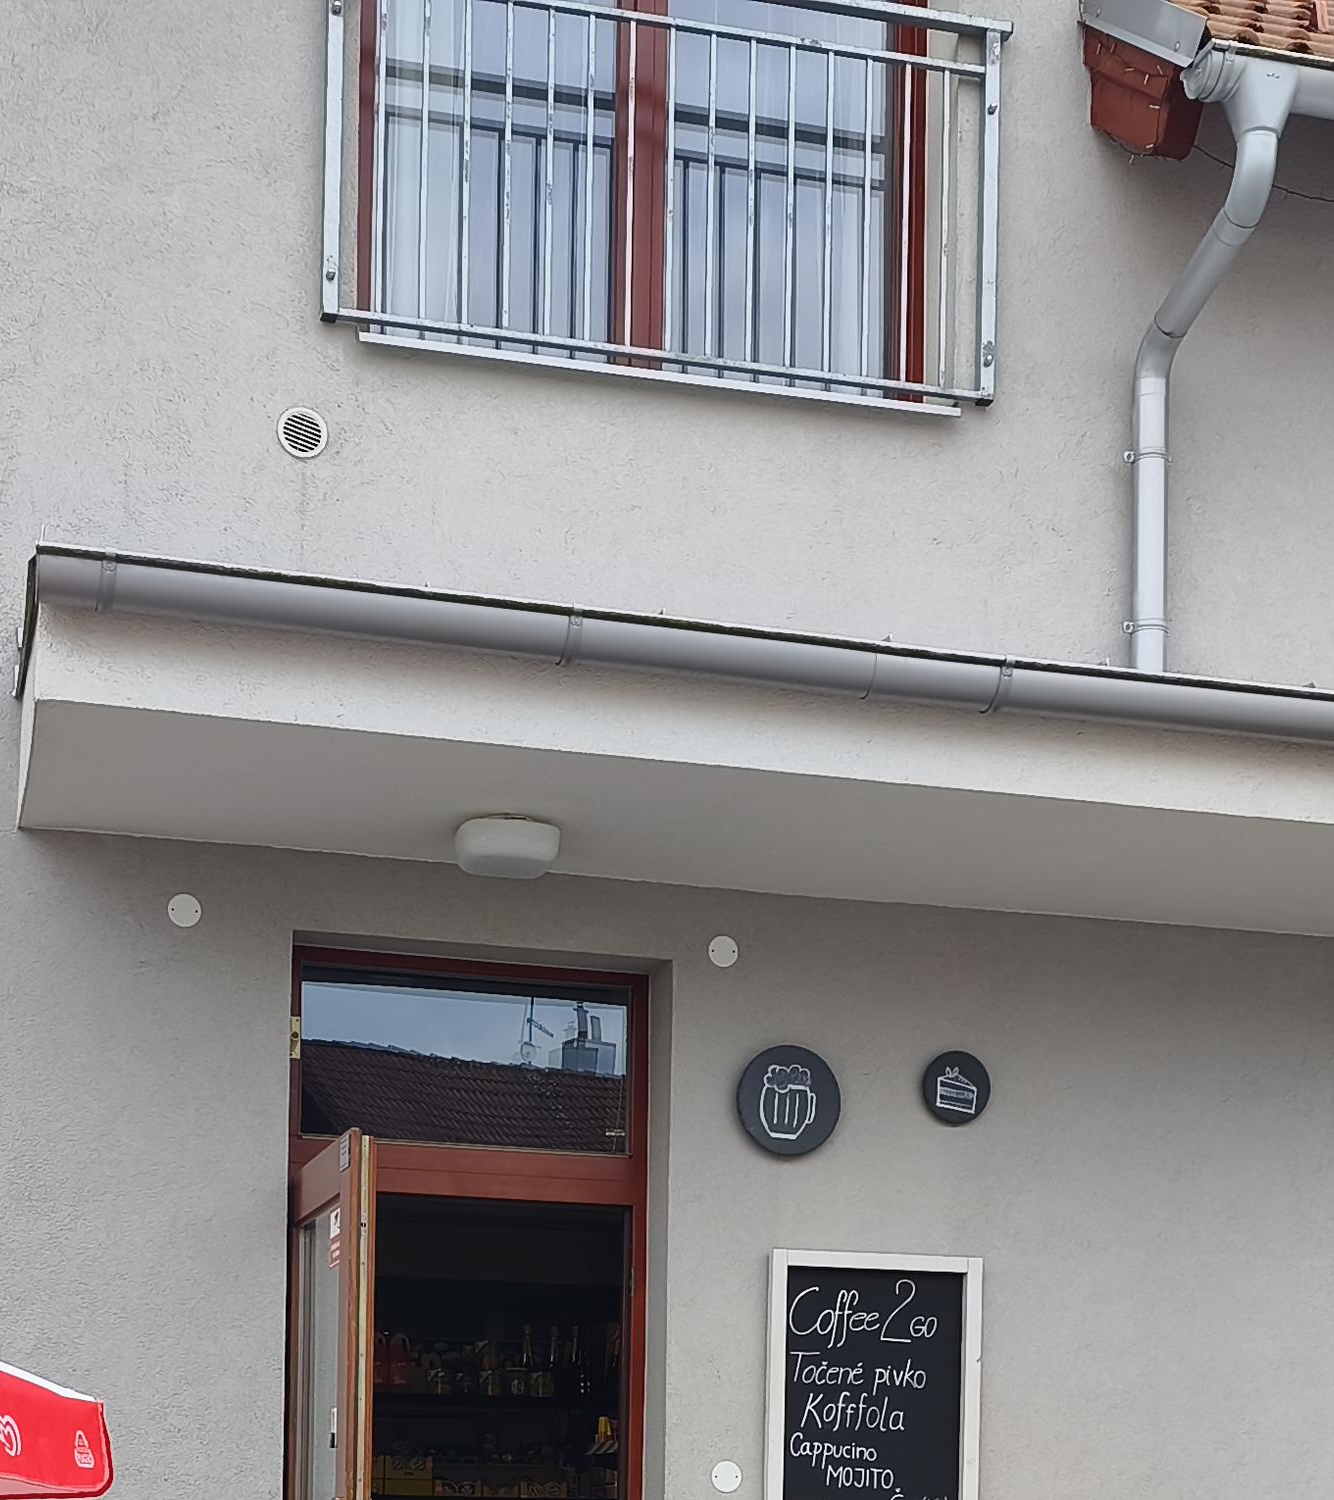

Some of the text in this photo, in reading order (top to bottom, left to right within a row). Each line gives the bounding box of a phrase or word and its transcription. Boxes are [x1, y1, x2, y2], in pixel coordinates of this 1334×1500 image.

[789, 1287, 880, 1348] Coffee
[880, 1279, 916, 1343] 2
[789, 1351, 927, 1395] Točené pivko
[789, 1432, 878, 1470] Cappucino
[825, 1464, 895, 1490] MOJITO
